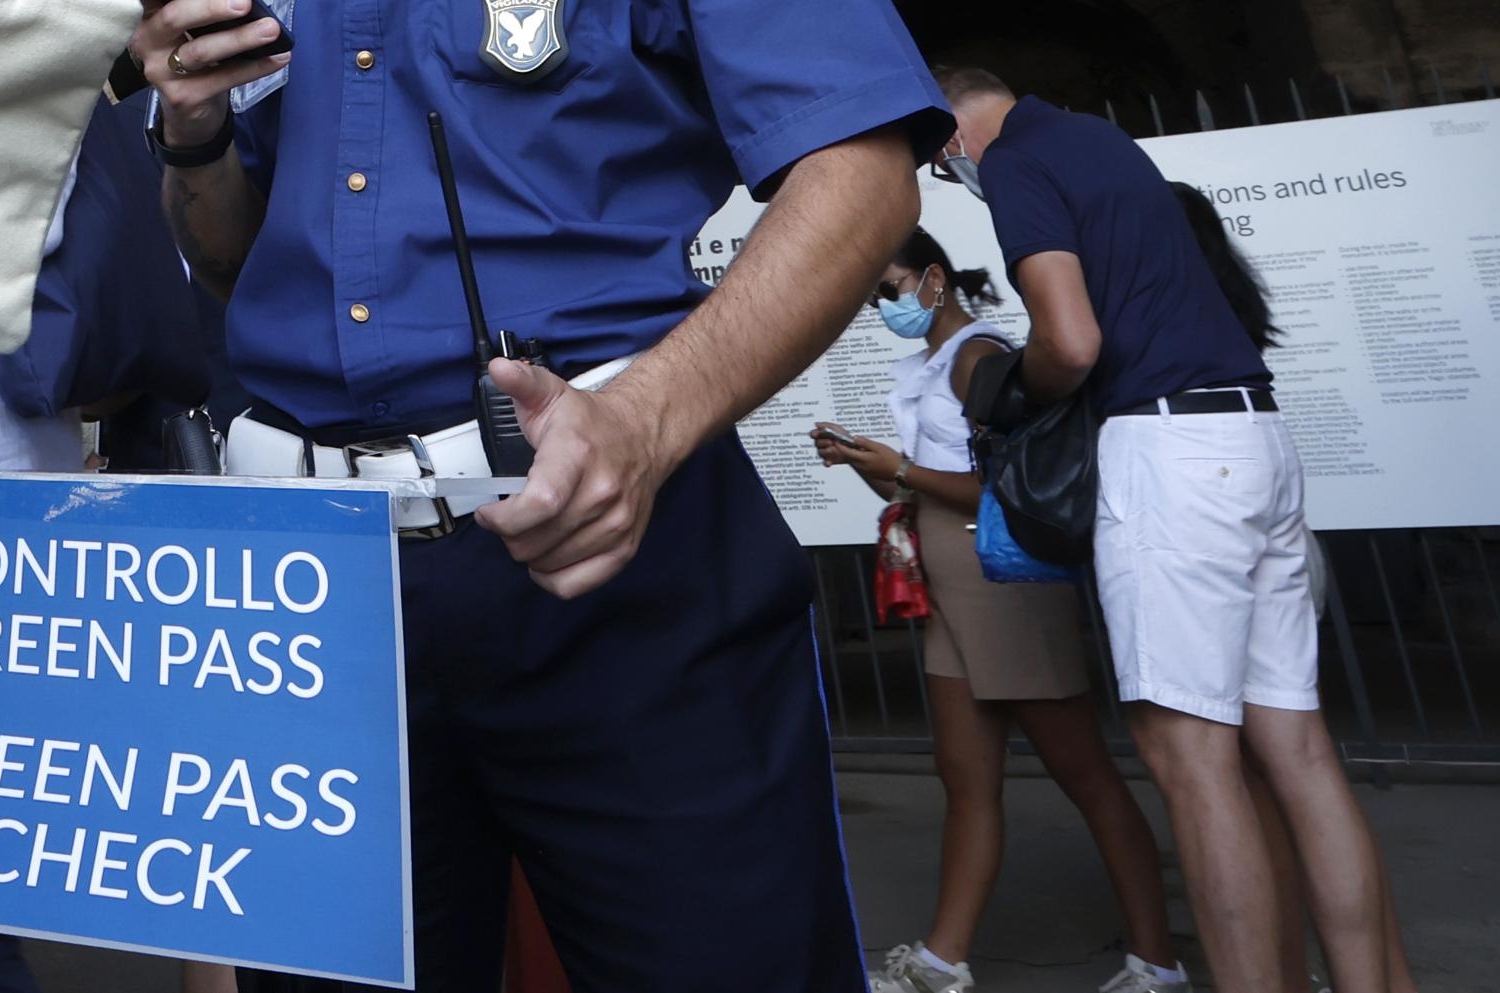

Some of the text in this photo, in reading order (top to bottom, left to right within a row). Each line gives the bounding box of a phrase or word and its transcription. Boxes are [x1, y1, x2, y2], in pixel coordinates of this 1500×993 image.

[1274, 173, 1327, 199] and
[1334, 168, 1407, 193] rules
[709, 239, 723, 255] e
[159, 624, 324, 699] PASS
[162, 752, 359, 836] PASS
